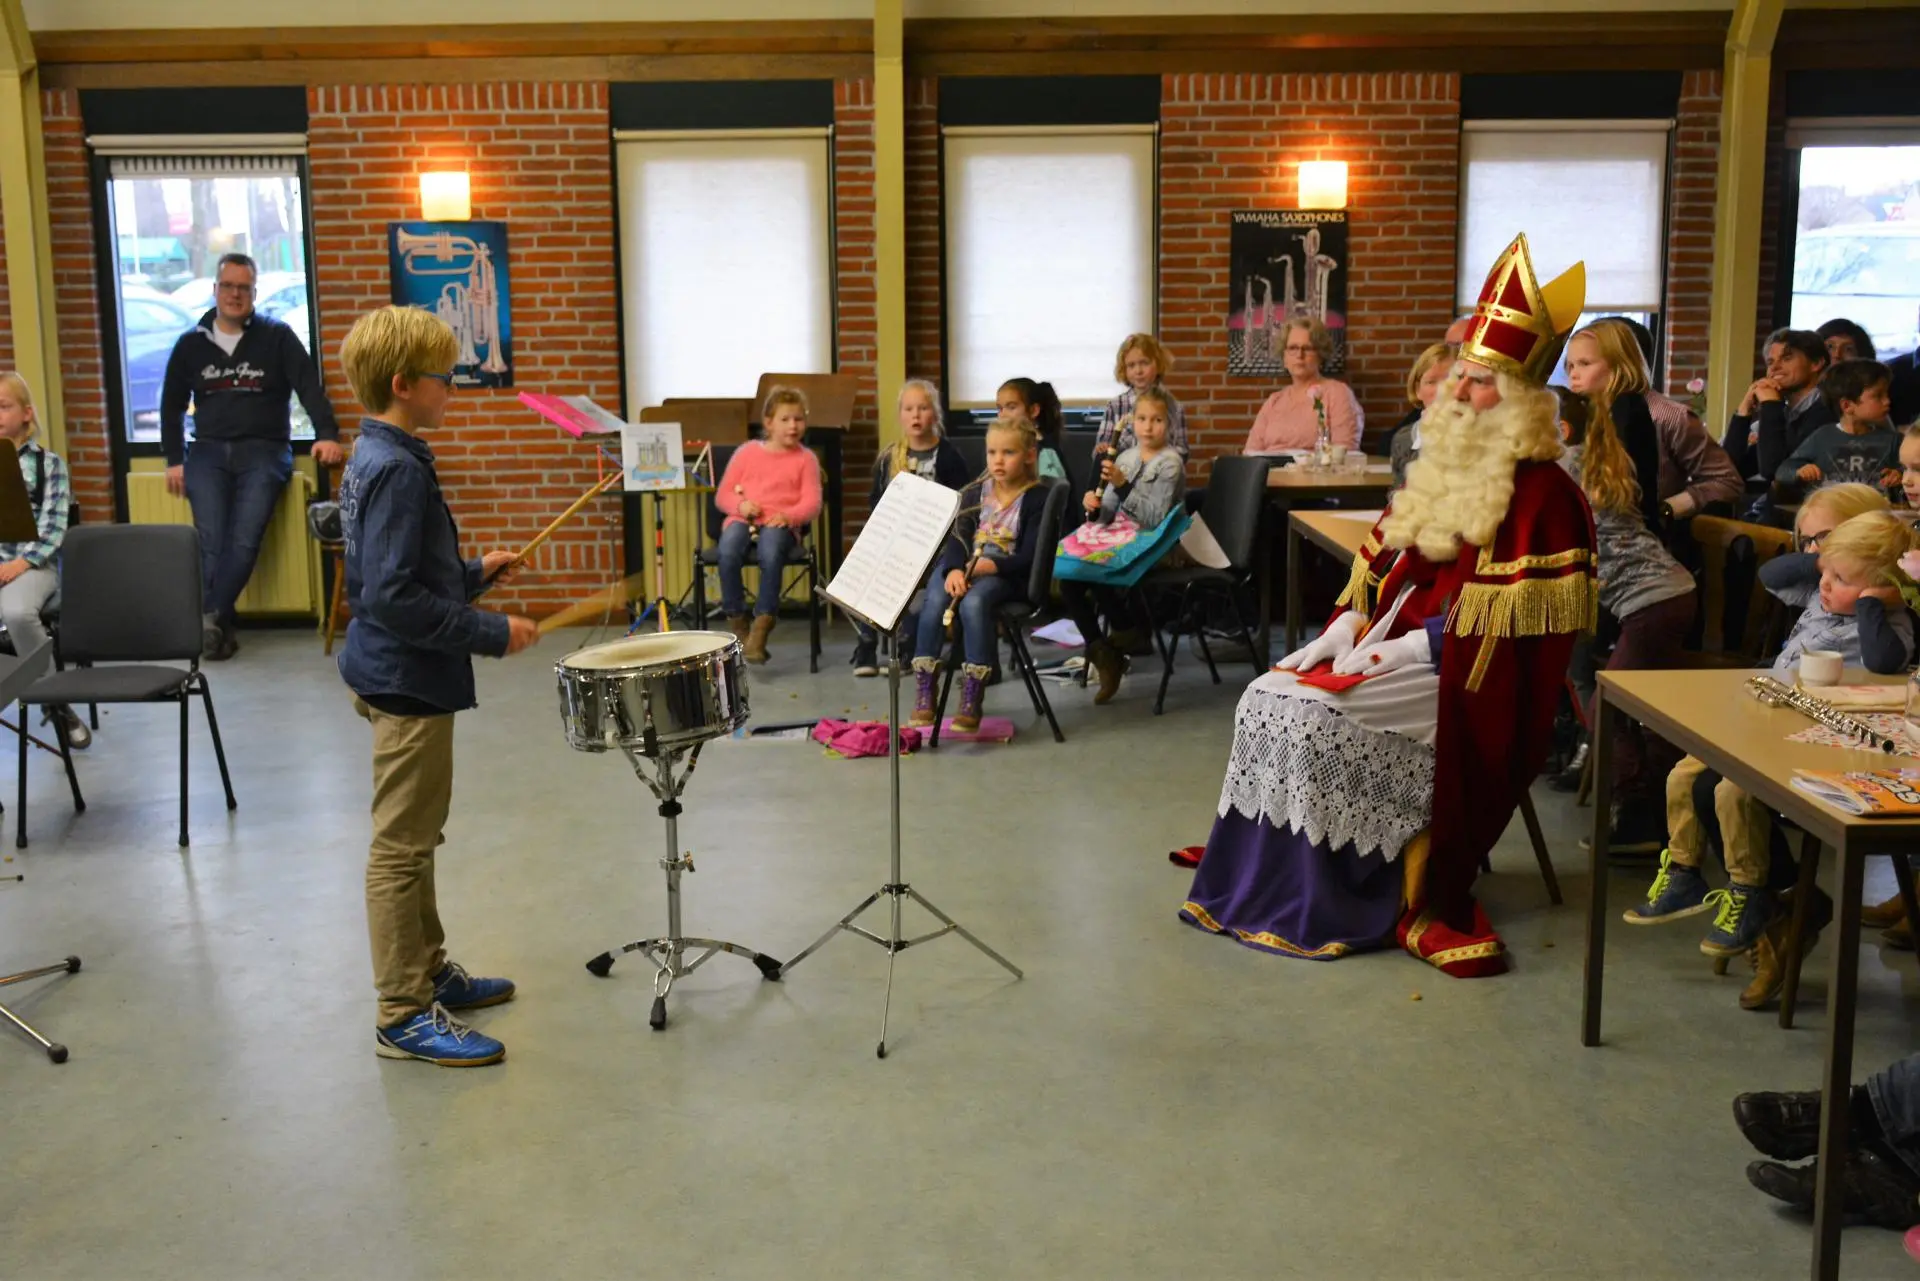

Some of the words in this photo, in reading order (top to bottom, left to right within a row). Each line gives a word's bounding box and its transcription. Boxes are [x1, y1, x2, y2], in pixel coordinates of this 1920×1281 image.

[1234, 212, 1279, 223] YAMAHA
[1281, 212, 1345, 223] SAXOPHONES
[1849, 455, 1865, 472] R
